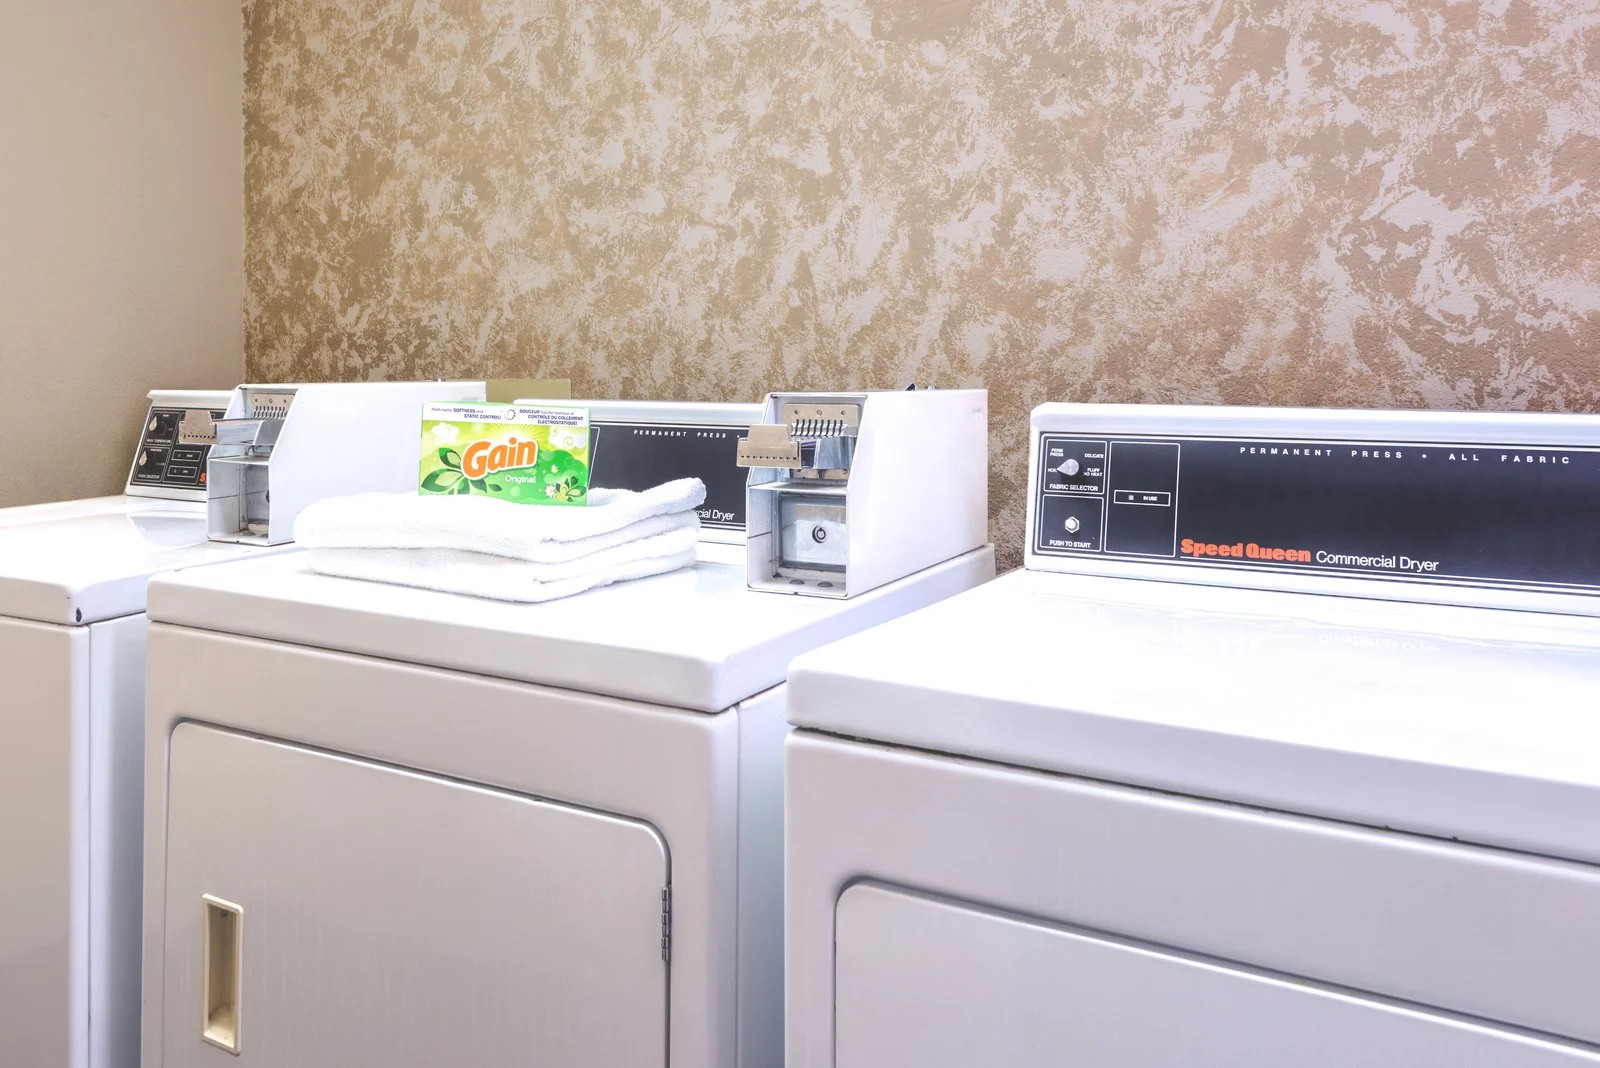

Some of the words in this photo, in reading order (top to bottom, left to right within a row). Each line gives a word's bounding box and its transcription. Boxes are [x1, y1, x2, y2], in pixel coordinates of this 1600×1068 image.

[633, 429, 687, 437] PERMANENT
[462, 436, 537, 478] Gain
[1240, 446, 1333, 457] PERMANENT
[1351, 450, 1404, 460] PRESS
[1448, 453, 1481, 462] ALL
[1501, 454, 1572, 465] FABRIC
[504, 474, 536, 485] Original
[712, 509, 735, 522] Dryer
[1049, 539, 1064, 547] PUSH
[1180, 538, 1244, 558] Speed
[1245, 543, 1312, 563] Queen
[1316, 550, 1397, 569] Commercial
[1399, 555, 1440, 573] Dryer
